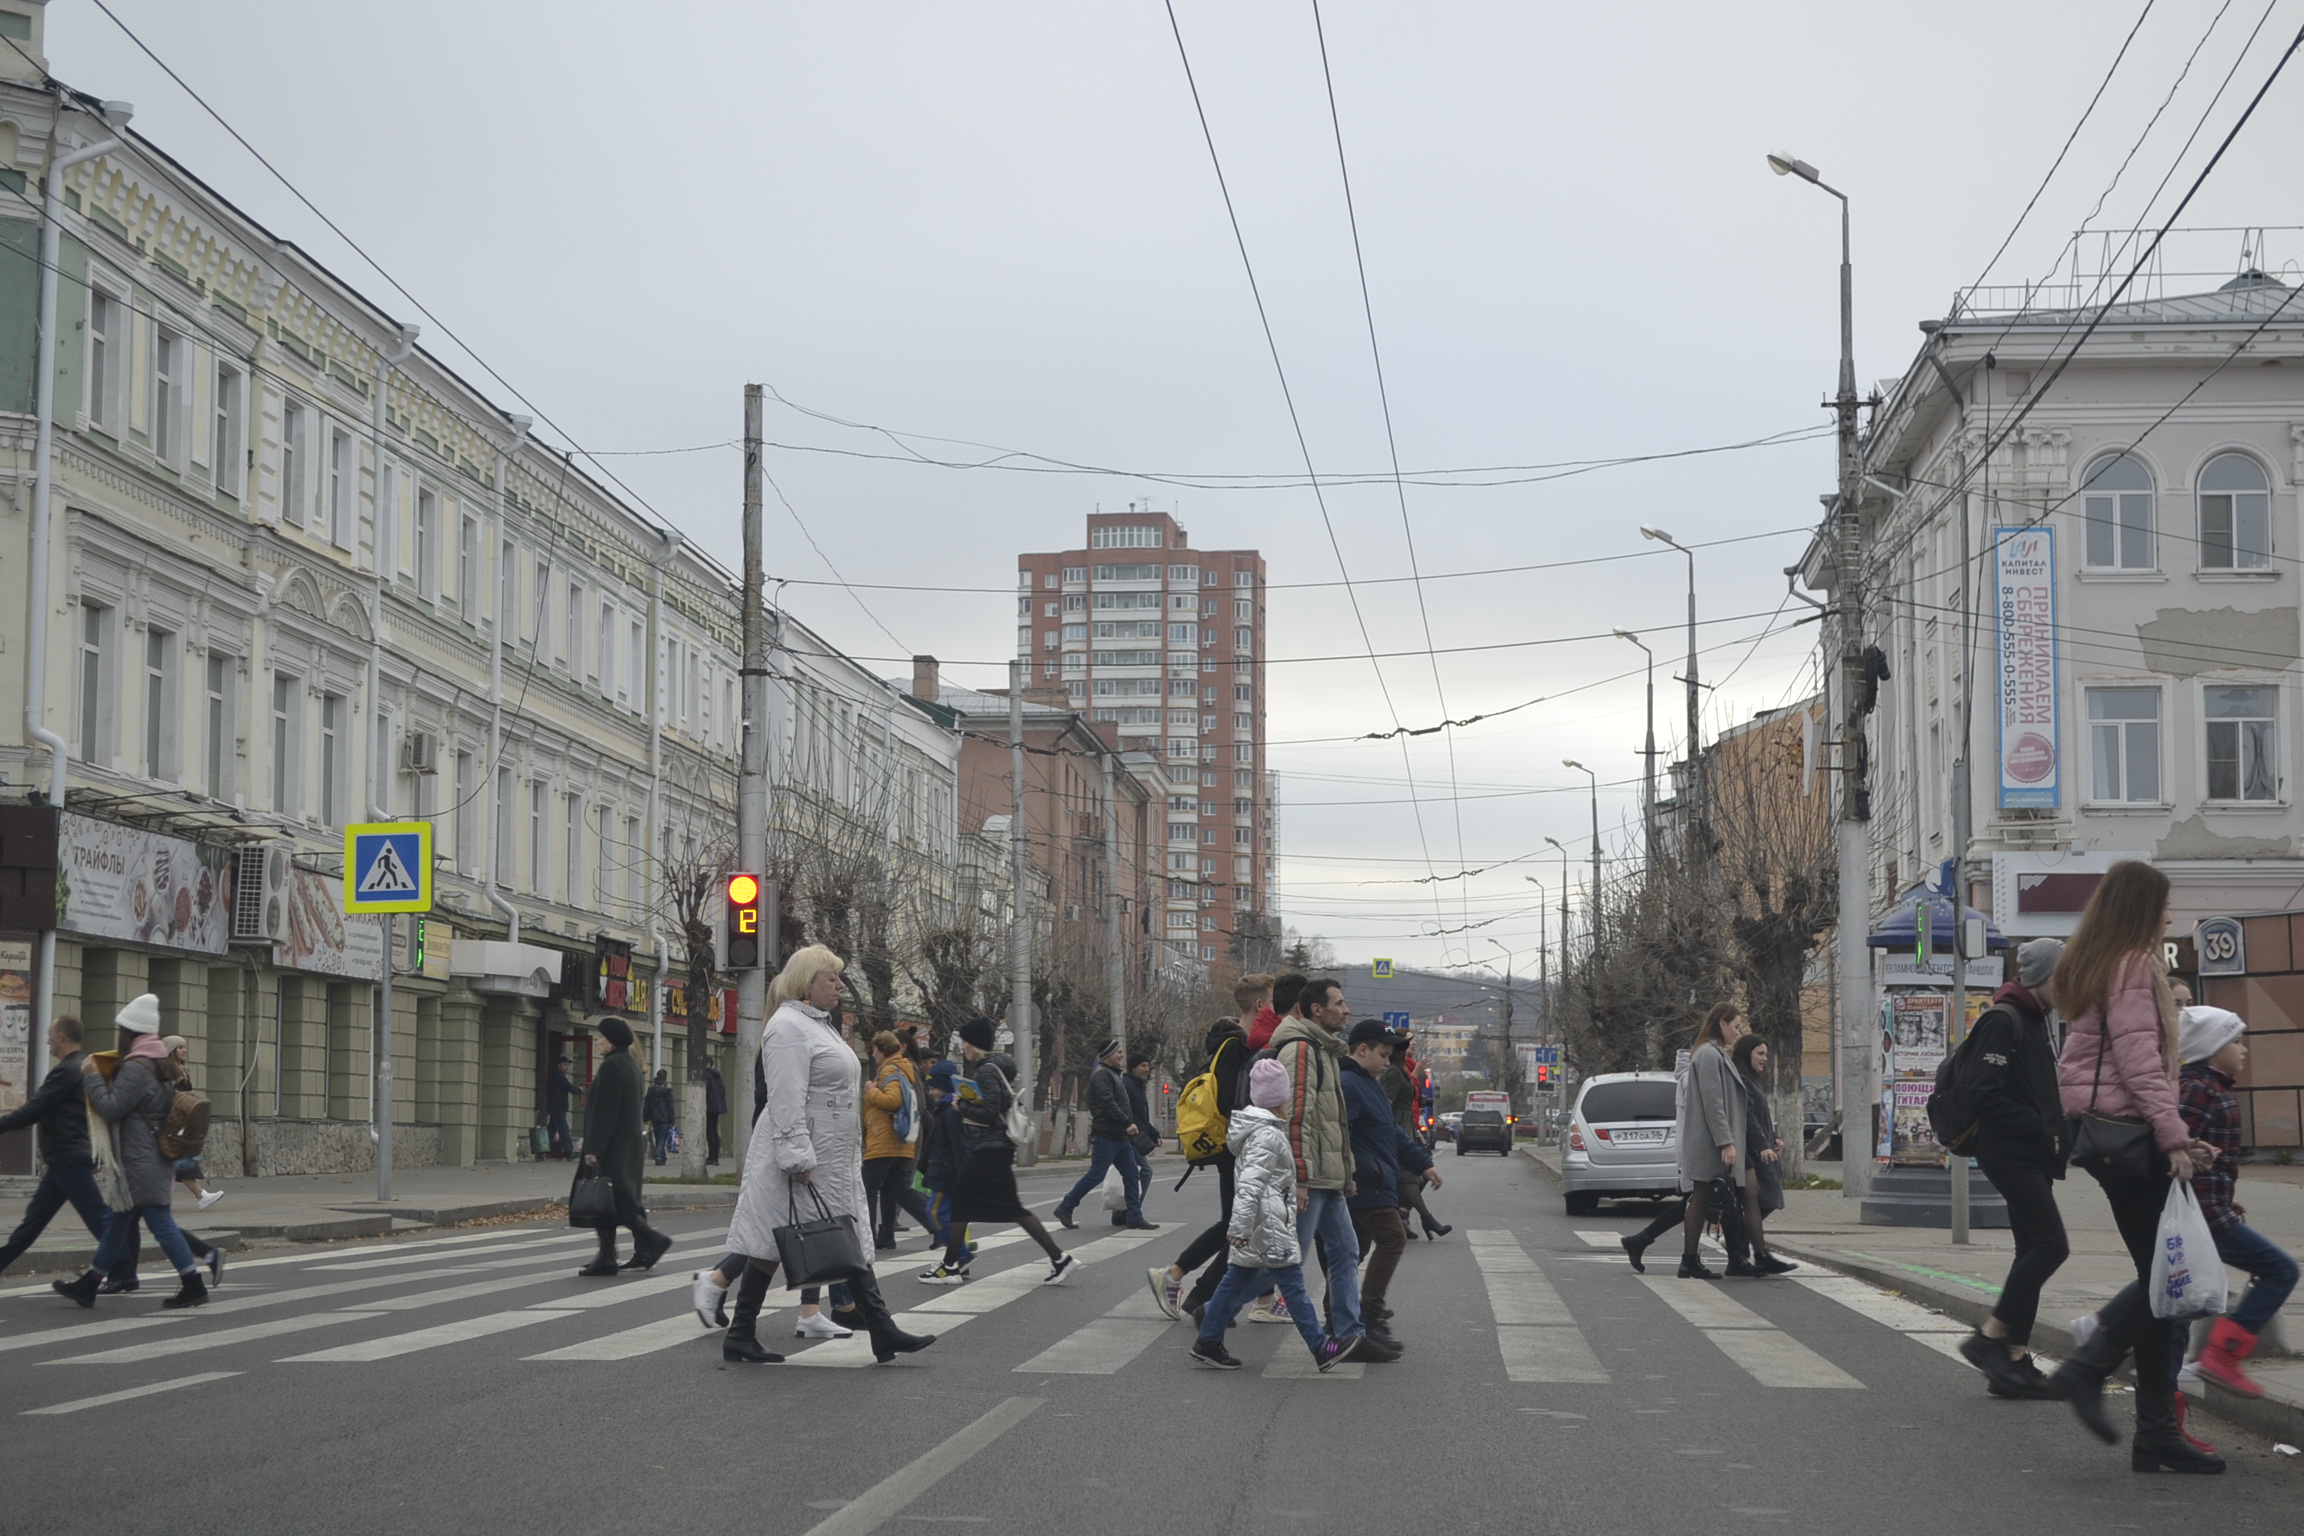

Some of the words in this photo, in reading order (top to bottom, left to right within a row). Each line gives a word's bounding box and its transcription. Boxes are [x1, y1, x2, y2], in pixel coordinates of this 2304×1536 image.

[2002, 586, 2016, 706] 8-800-555-0-555
[2016, 586, 2035, 724] СБЕРЕЖЕНИЯ
[2033, 586, 2051, 724] ПРИНИМАЕМ
[74, 845, 125, 876] ТРАЙФЛЫ
[2206, 932, 2236, 960] 39
